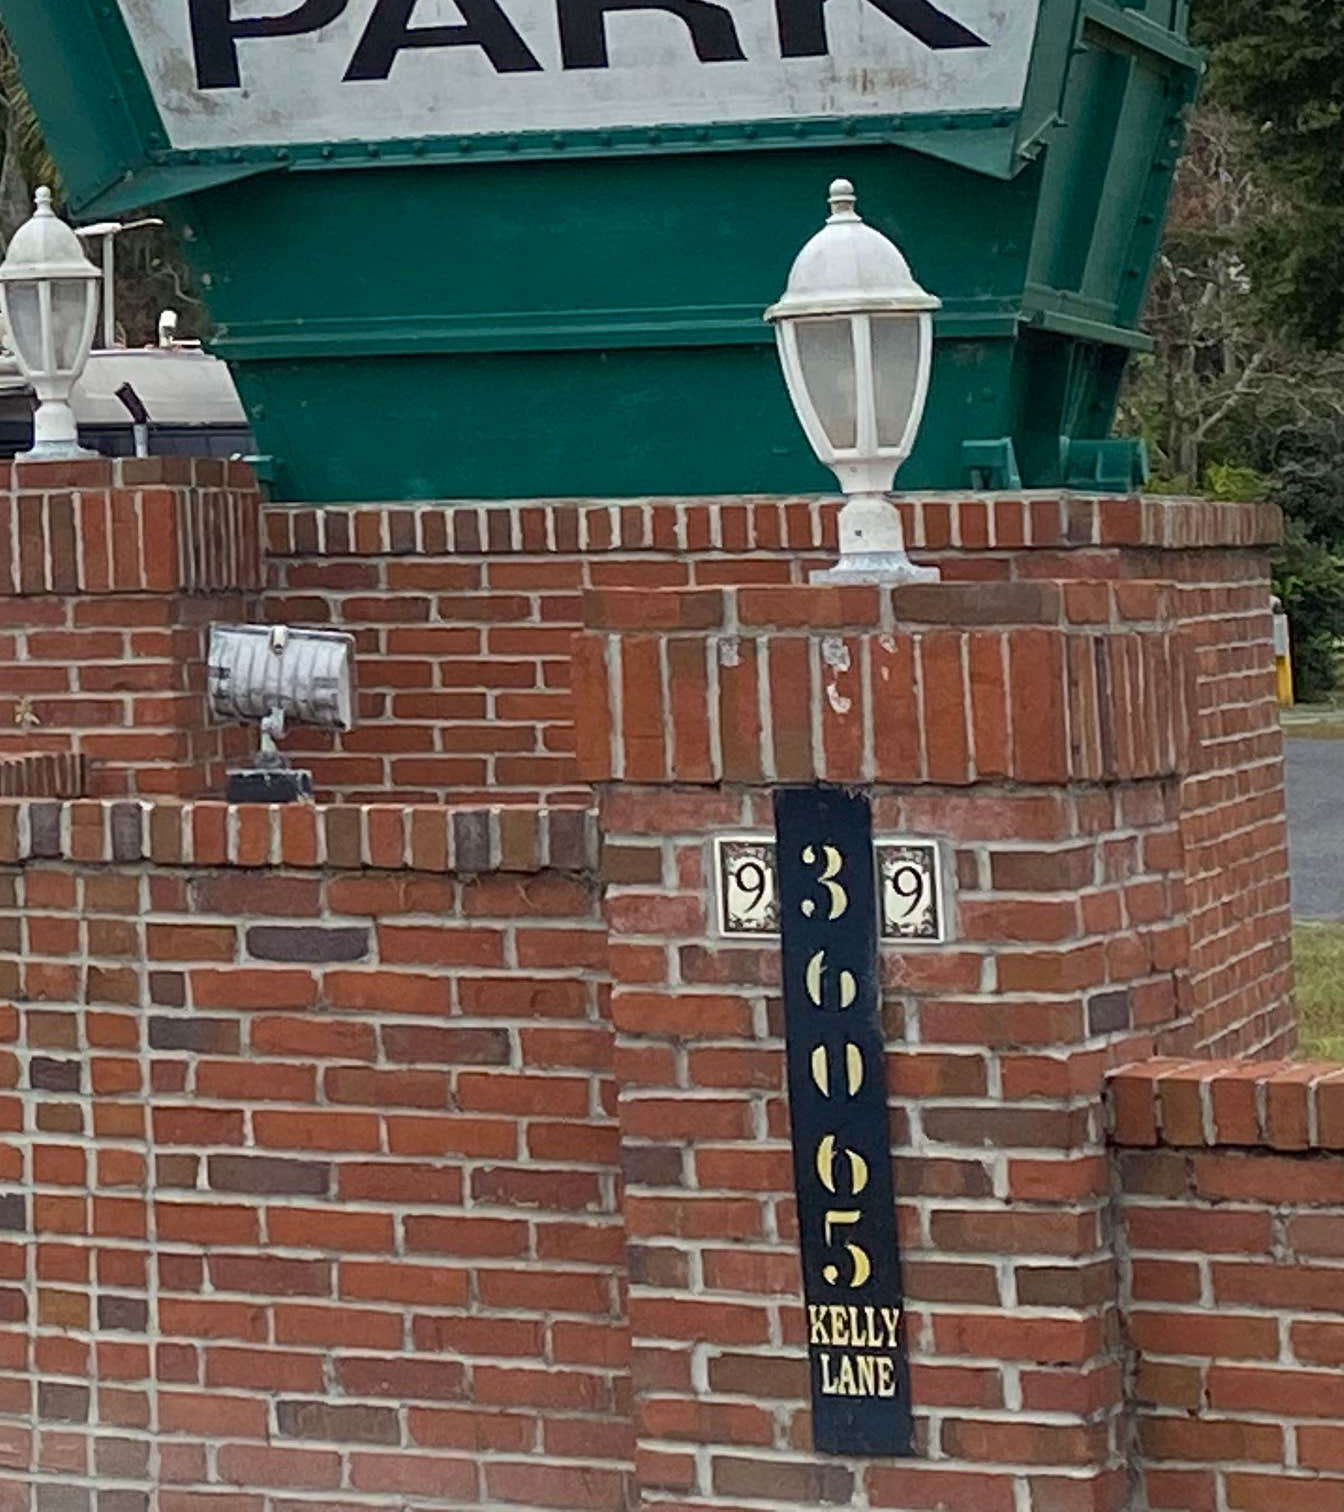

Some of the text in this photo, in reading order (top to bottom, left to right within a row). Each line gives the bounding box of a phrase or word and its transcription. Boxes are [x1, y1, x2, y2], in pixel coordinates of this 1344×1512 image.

[736, 861, 765, 915] 9
[891, 865, 924, 919] 9
[807, 1302, 901, 1348] KELLY
[819, 1352, 897, 1398] LANE
